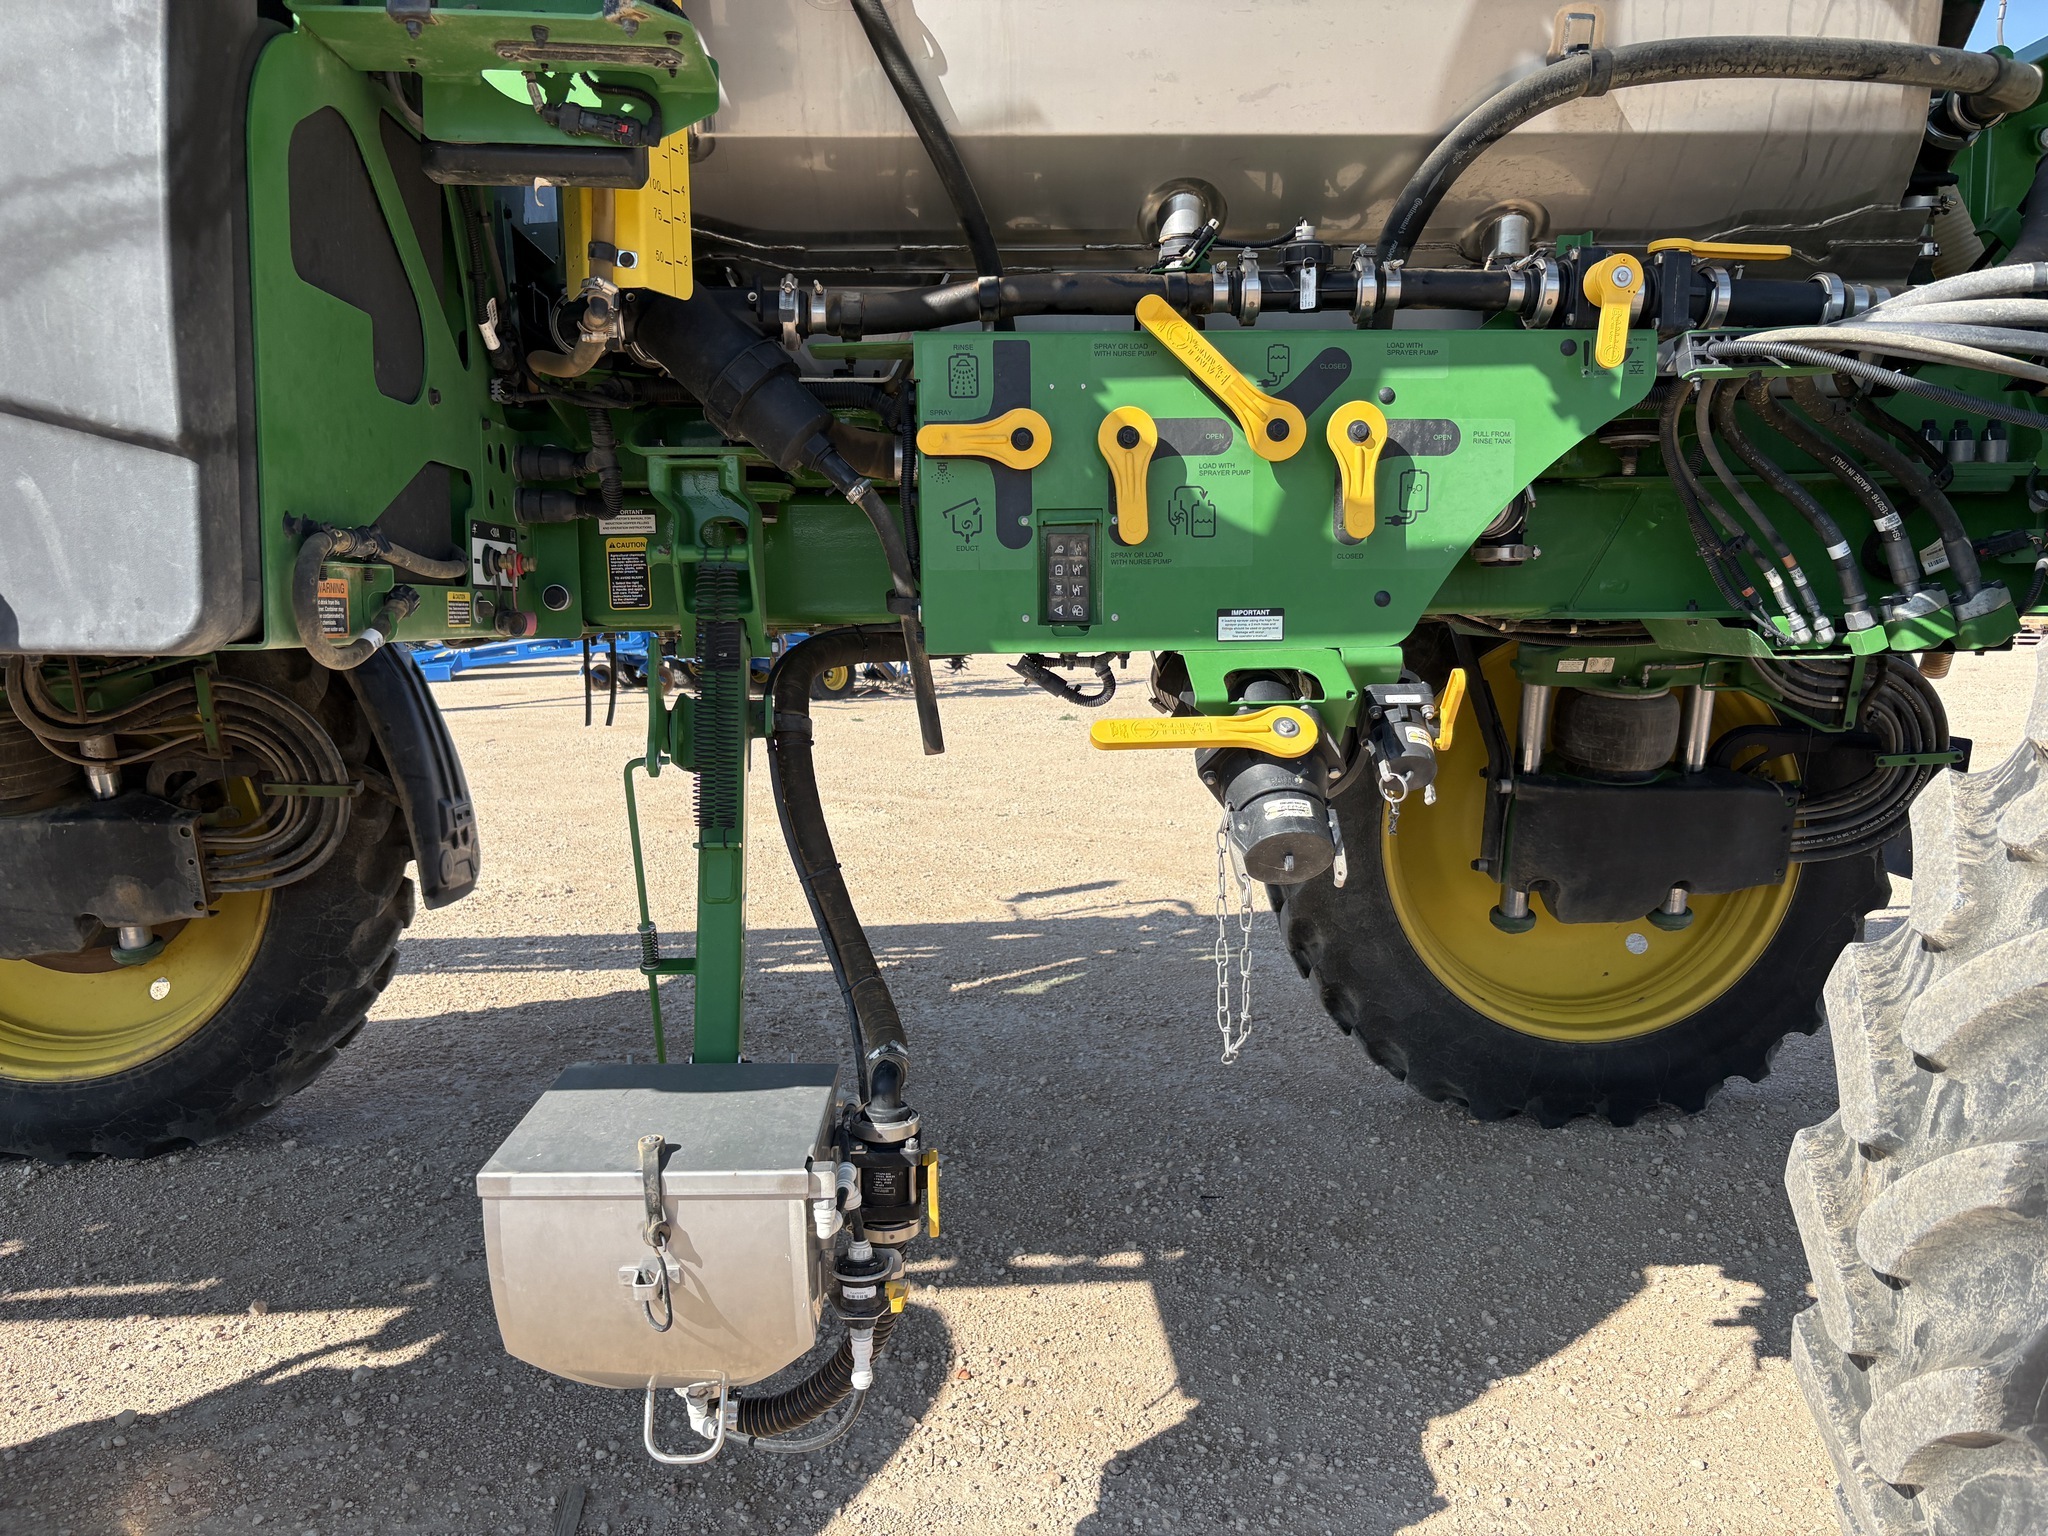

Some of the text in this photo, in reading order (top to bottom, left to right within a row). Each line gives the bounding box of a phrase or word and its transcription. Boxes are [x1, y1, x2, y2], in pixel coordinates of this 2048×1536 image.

[679, 144, 684, 155] 5
[682, 186, 686, 196] 4
[653, 207, 662, 220] 75
[682, 212, 686, 224] 3
[1400, 198, 1424, 230] Continental
[656, 250, 664, 262] 50
[684, 256, 688, 266] 2
[1320, 362, 1347, 370] CLOSED
[1830, 454, 1848, 470] ITALY
[1853, 473, 1872, 493] MADE
